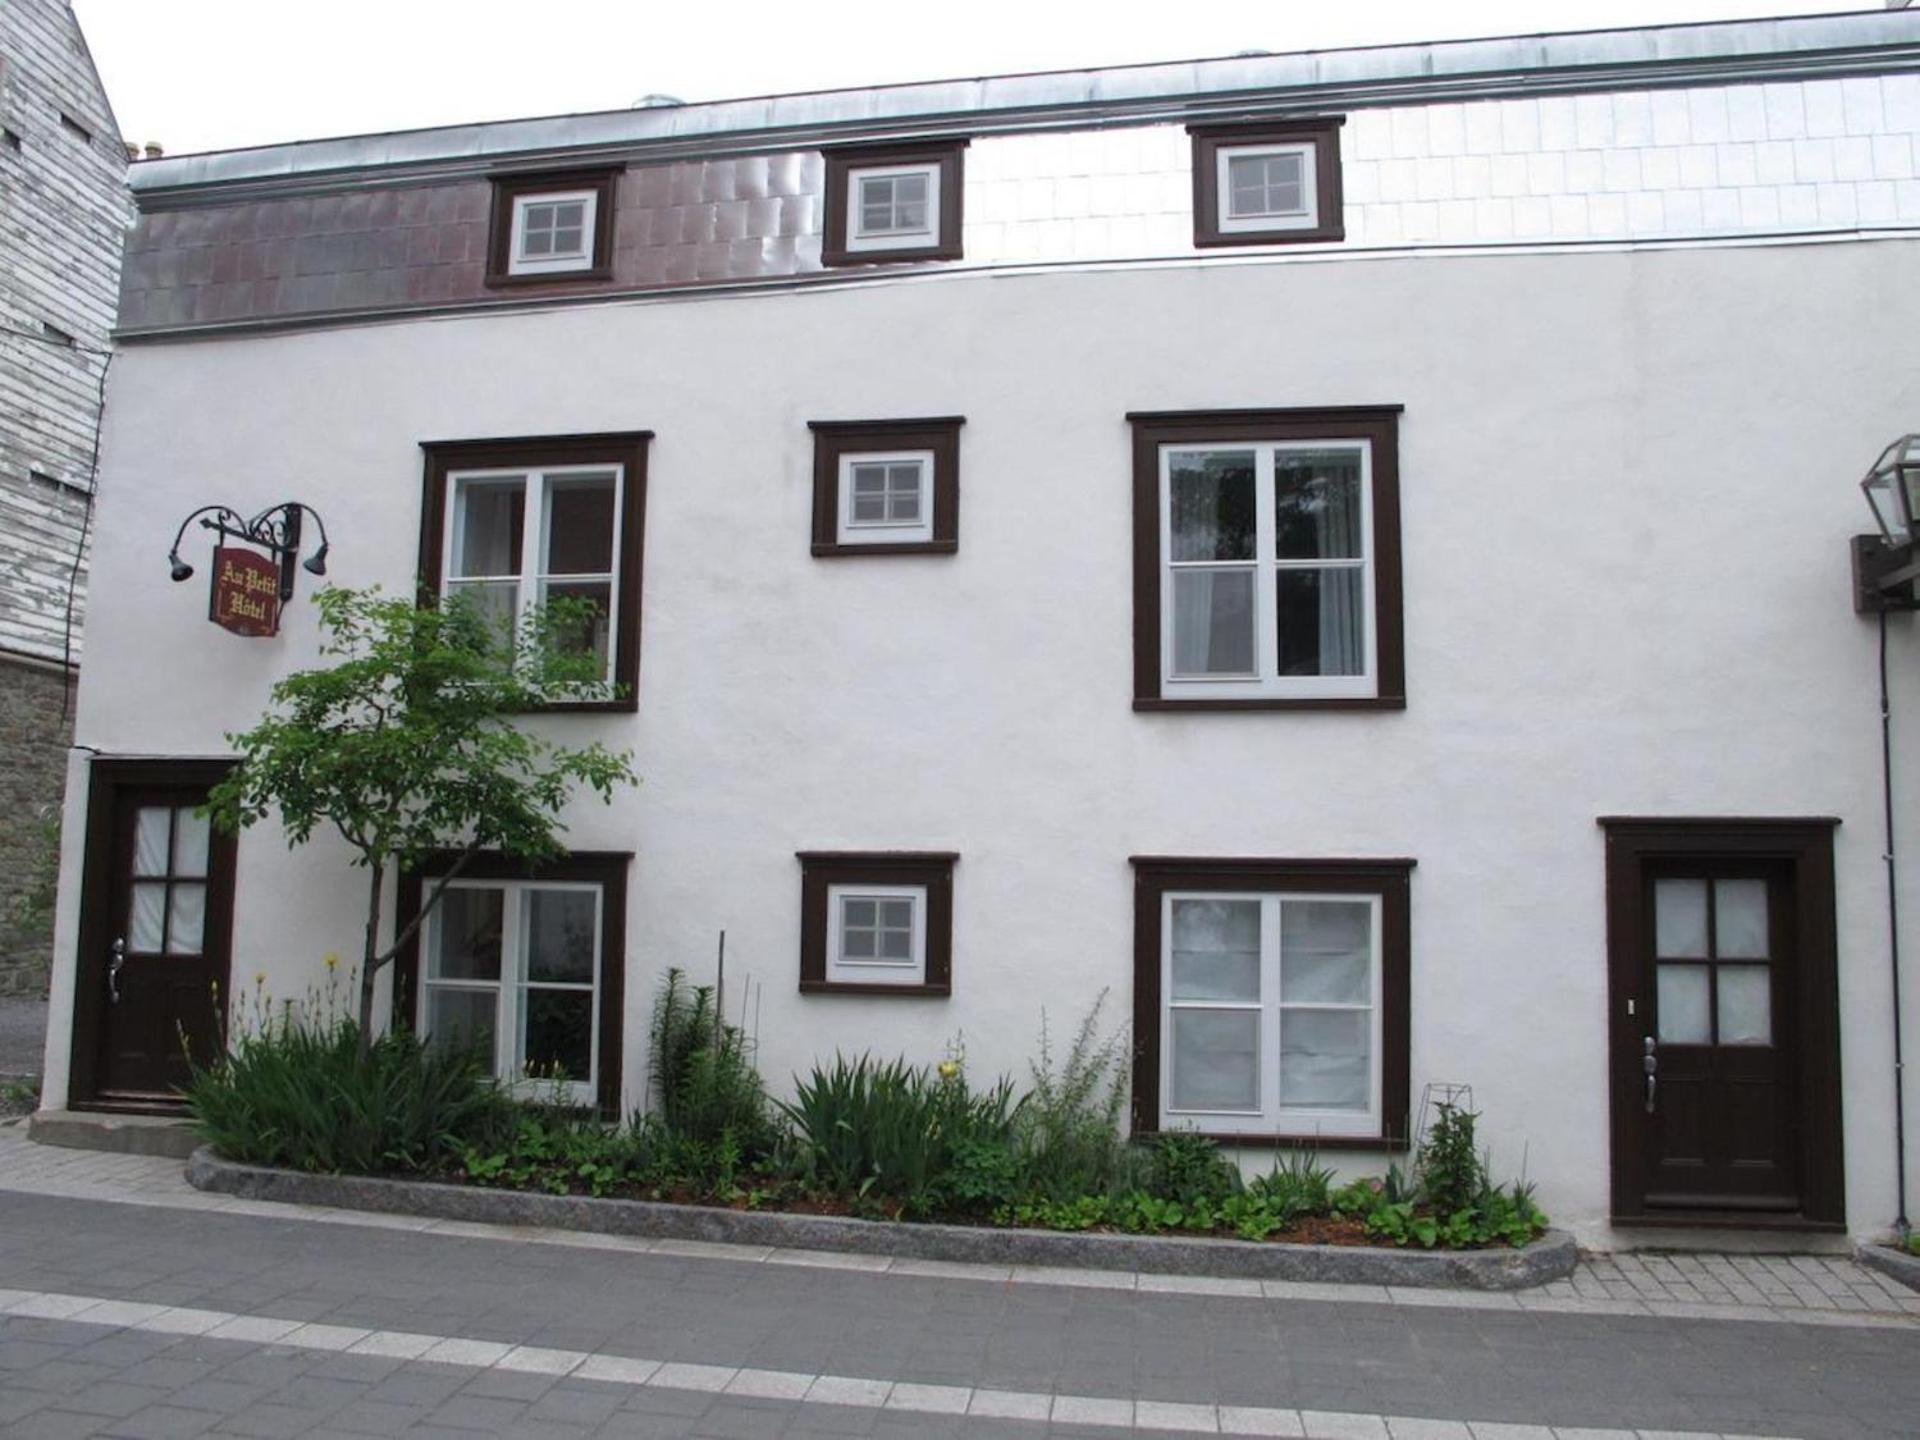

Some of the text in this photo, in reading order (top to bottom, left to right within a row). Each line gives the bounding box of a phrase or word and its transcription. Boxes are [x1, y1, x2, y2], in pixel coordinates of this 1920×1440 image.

[221, 561, 276, 595] Au Petit
[230, 591, 265, 620] Hôtel
